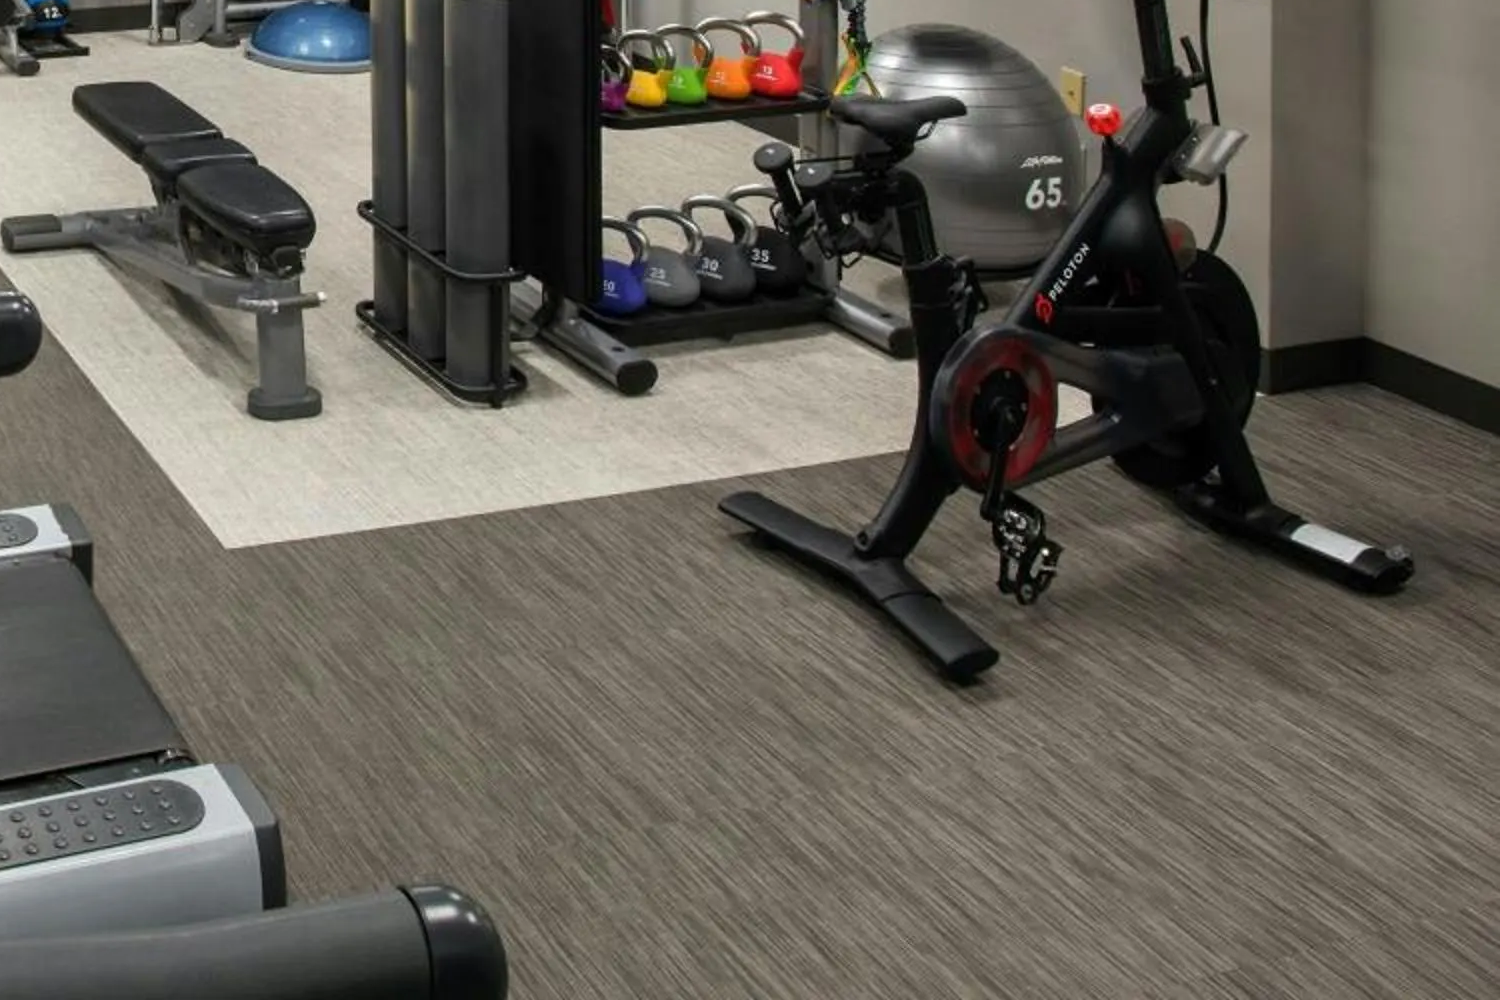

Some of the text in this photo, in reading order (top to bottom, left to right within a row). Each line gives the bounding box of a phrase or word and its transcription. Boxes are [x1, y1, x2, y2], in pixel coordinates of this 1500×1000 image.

[43, 5, 59, 19] 12
[1025, 176, 1063, 210] 65
[1048, 242, 1090, 302] PELOTON
